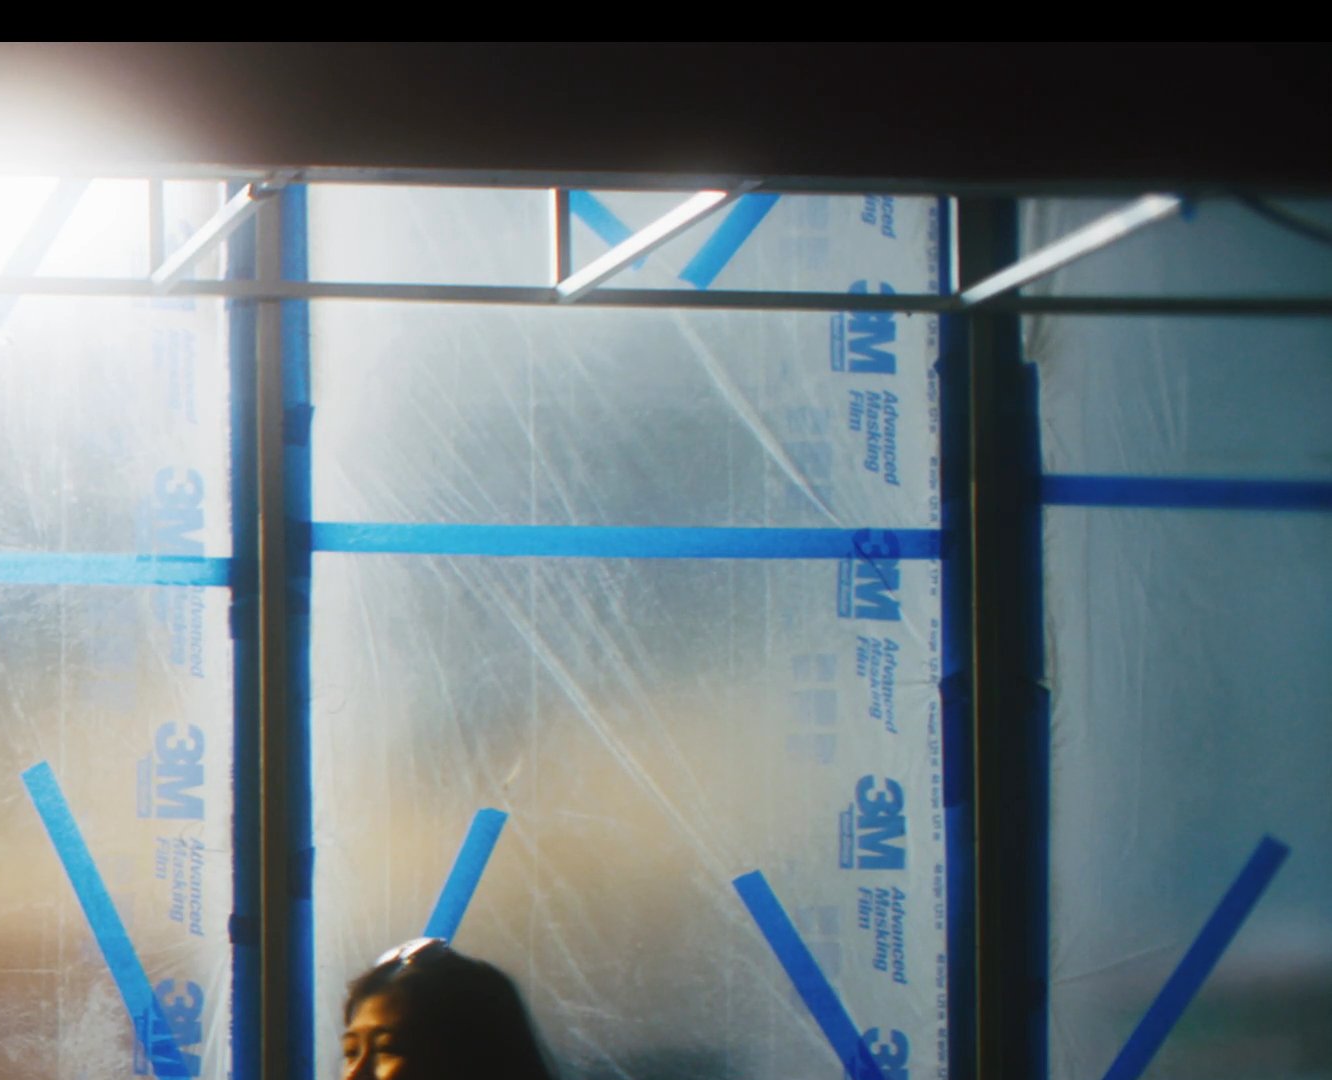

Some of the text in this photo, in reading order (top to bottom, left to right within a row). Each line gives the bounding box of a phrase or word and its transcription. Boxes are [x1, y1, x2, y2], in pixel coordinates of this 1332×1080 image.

[848, 389, 862, 432] Film
[864, 390, 881, 473] Masking
[883, 389, 900, 486] Advanced
[154, 466, 205, 563] 3M
[854, 530, 902, 620] 3M
[855, 635, 870, 677] Film
[868, 636, 885, 720] Masking
[881, 638, 900, 734] Advanced
[157, 723, 204, 819] 3M
[155, 836, 170, 880] Film
[856, 775, 905, 869] 3M
[170, 837, 187, 923] Masking
[190, 836, 205, 938] Advanced
[857, 886, 873, 930] Film
[872, 887, 892, 972] Masking
[890, 887, 908, 985] Advanced
[153, 980, 204, 1077] 3M
